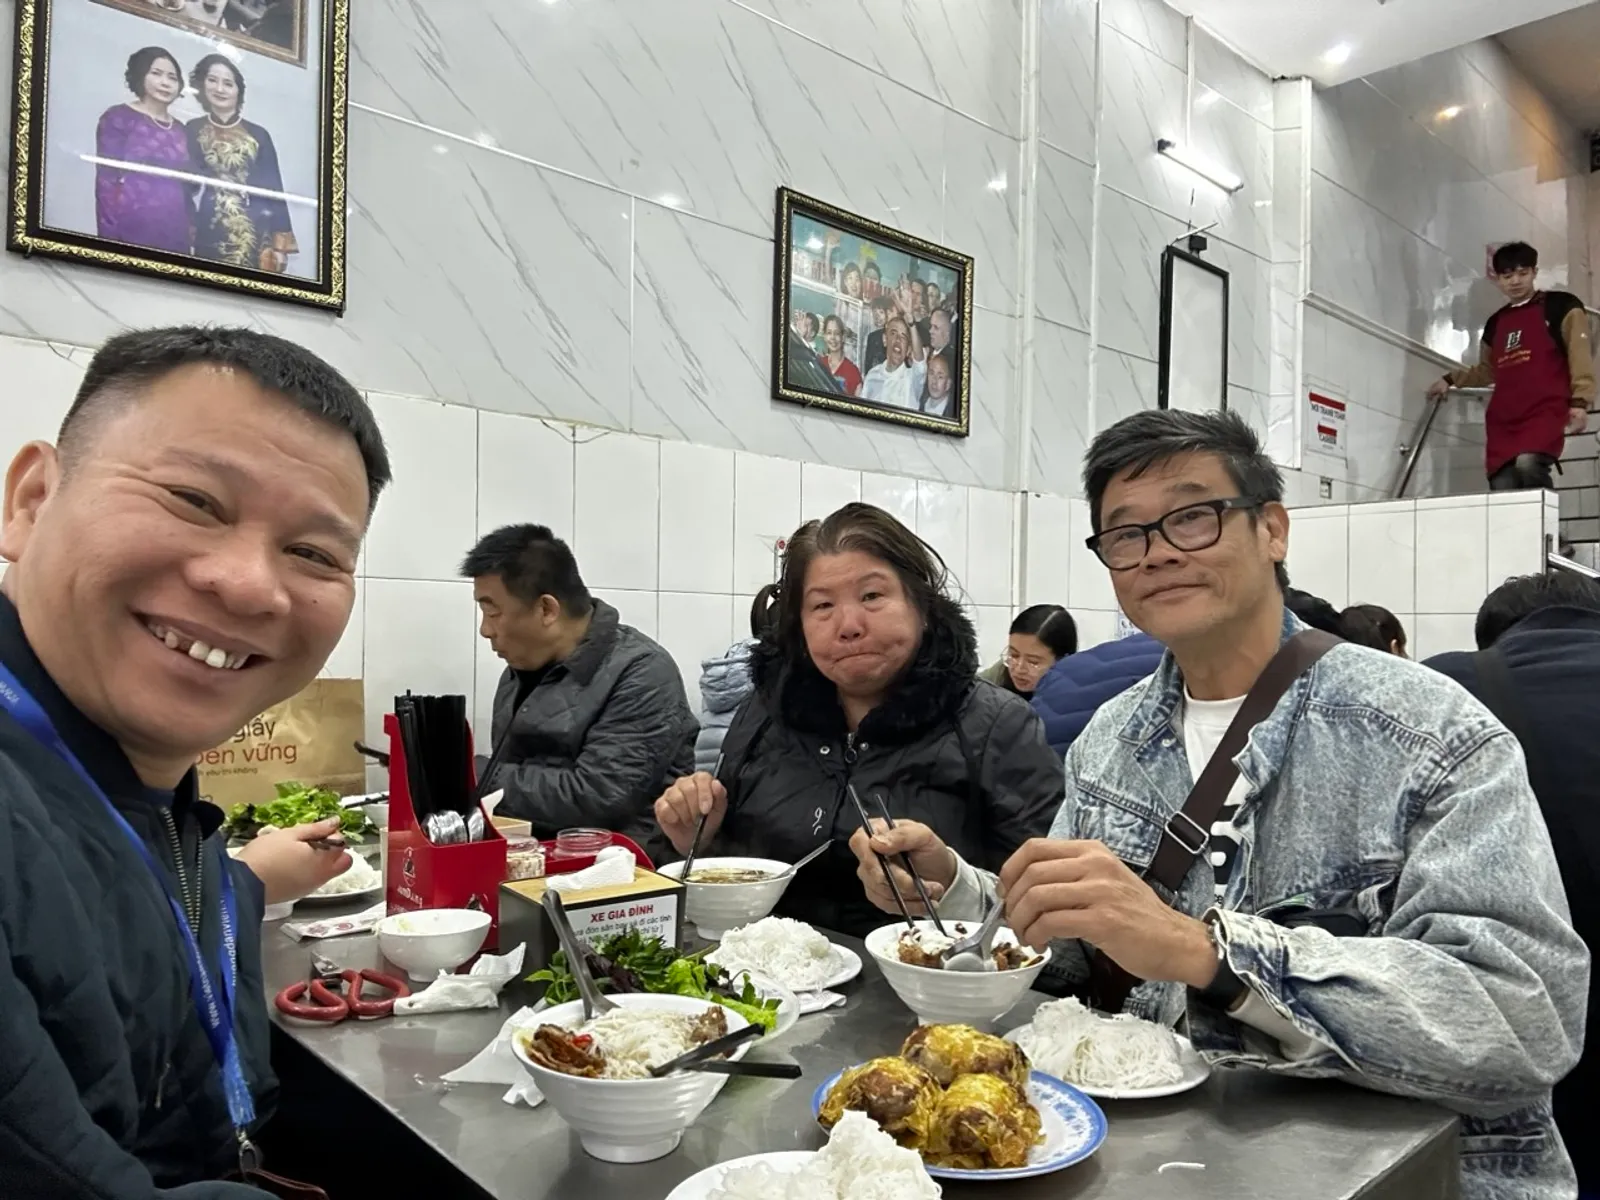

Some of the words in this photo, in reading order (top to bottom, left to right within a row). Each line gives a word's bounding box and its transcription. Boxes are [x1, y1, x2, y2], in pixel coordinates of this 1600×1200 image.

[242, 743, 298, 765] vững
[590, 912, 605, 923] XE
[607, 909, 626, 920] GIA
[628, 904, 654, 917] ĐÌNH
